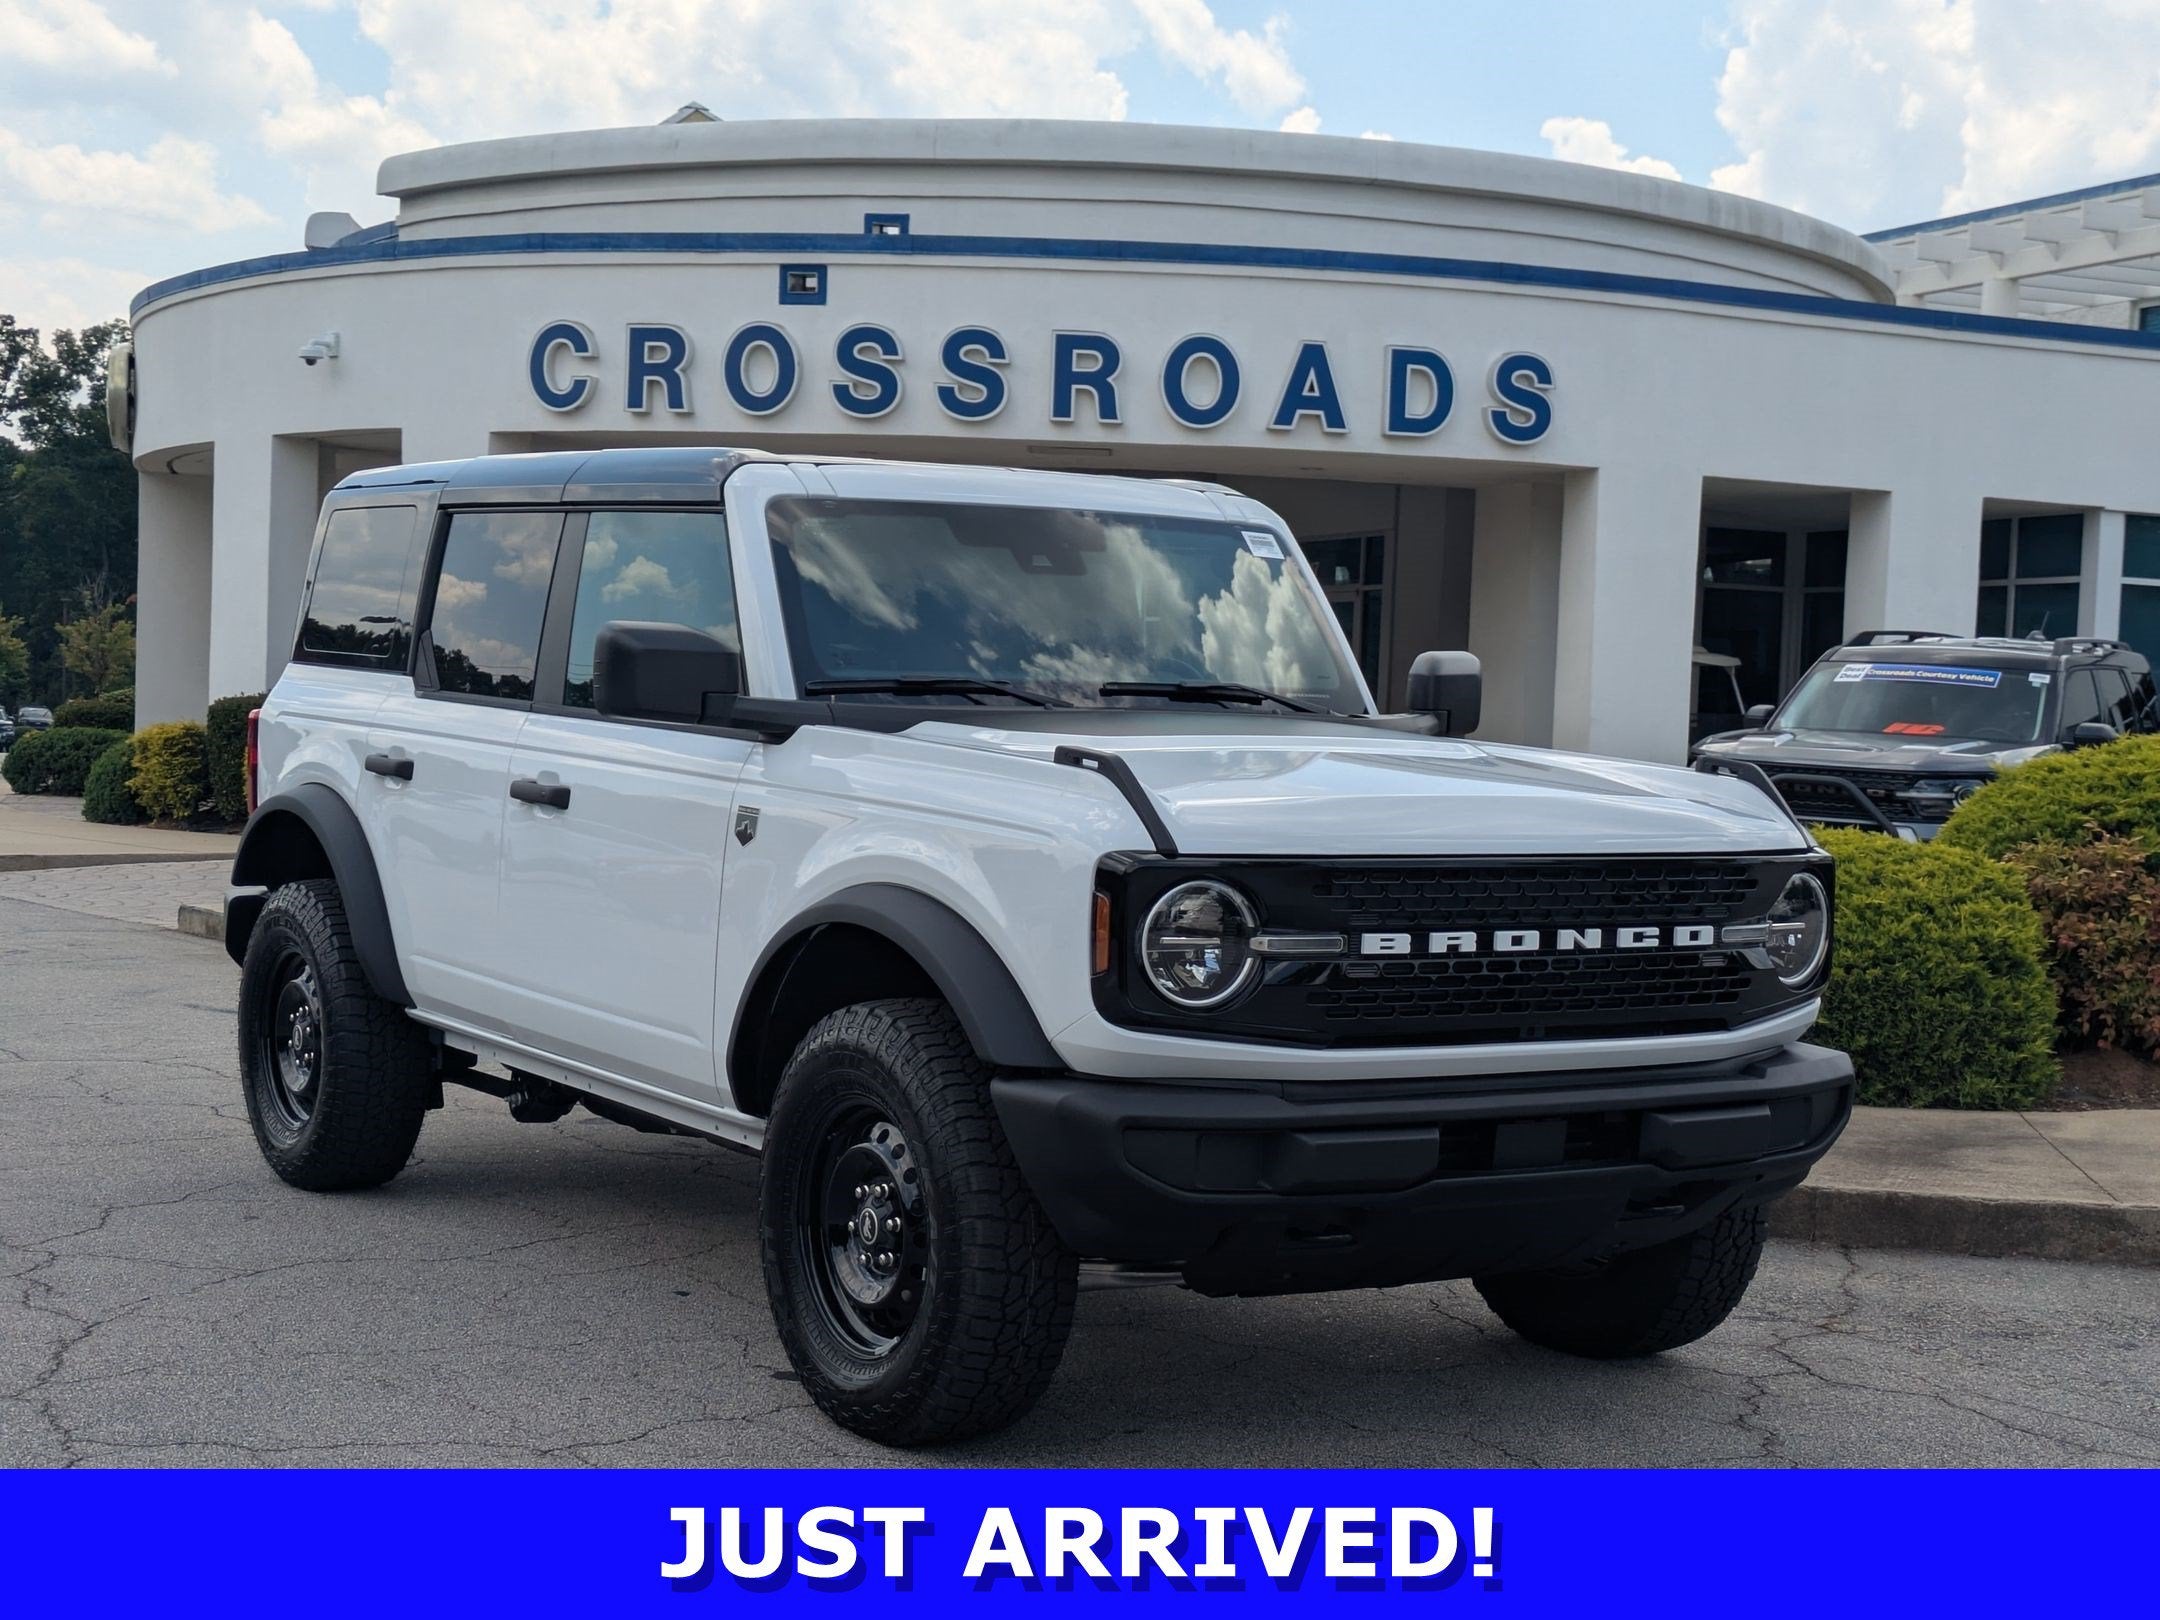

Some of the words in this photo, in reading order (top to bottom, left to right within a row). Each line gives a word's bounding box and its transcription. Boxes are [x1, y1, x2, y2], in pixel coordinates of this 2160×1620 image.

[528, 319, 1555, 446] CROSSROADS
[1867, 668, 1915, 677] Crossroads
[1916, 670, 1958, 680] Courtesy
[1959, 673, 1995, 683] Vehicle
[1361, 925, 1714, 954] BRONCO
